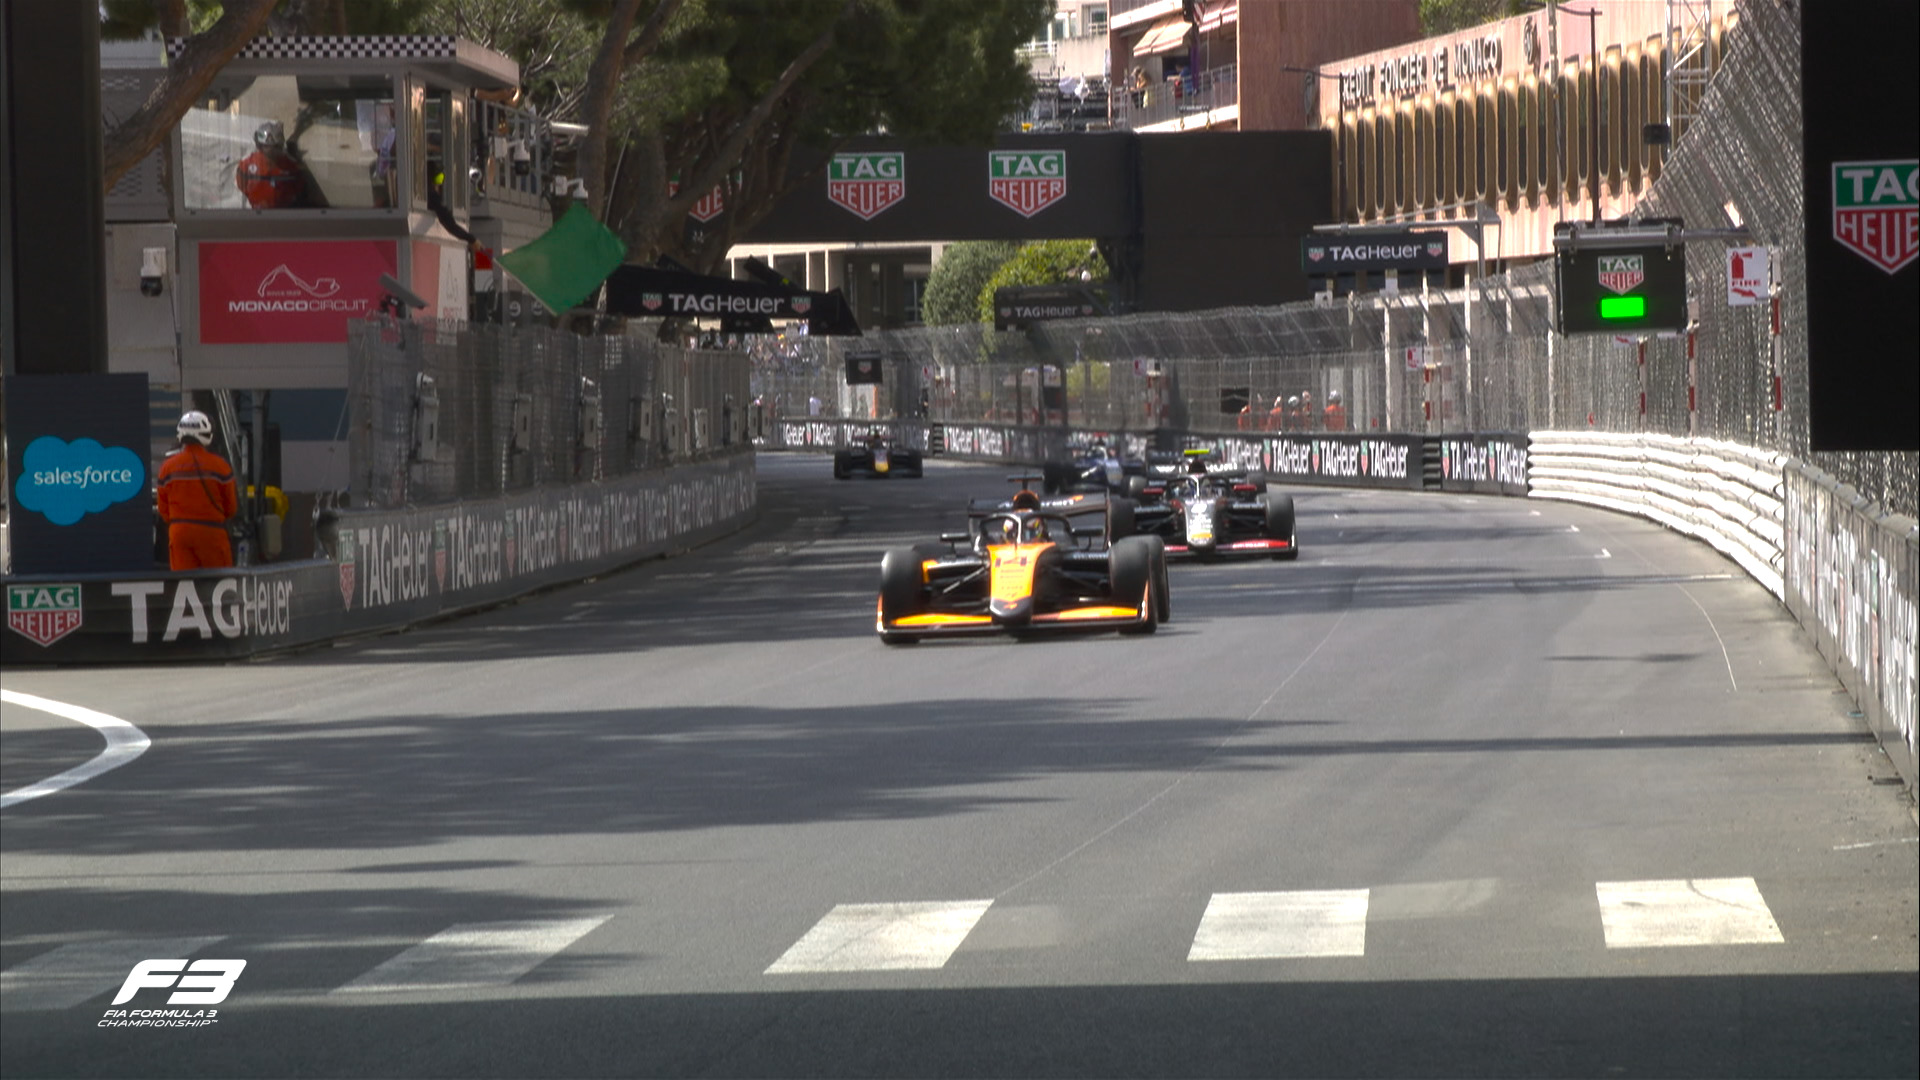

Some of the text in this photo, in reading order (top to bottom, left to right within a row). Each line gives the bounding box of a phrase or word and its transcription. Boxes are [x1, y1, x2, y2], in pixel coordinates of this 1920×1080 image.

[1339, 34, 1498, 101] REDIT FONCIER DE MONACO
[834, 158, 898, 178] TAG
[996, 155, 1059, 176] TAG
[832, 183, 900, 218] HEUER
[994, 181, 1061, 211] HEUER
[1840, 212, 1919, 265] HEUE
[1602, 258, 1639, 271] TAG
[1600, 272, 1643, 293] HEUER
[34, 465, 132, 489] salesforce
[14, 588, 74, 608] TAG
[12, 612, 78, 641] HEUER
